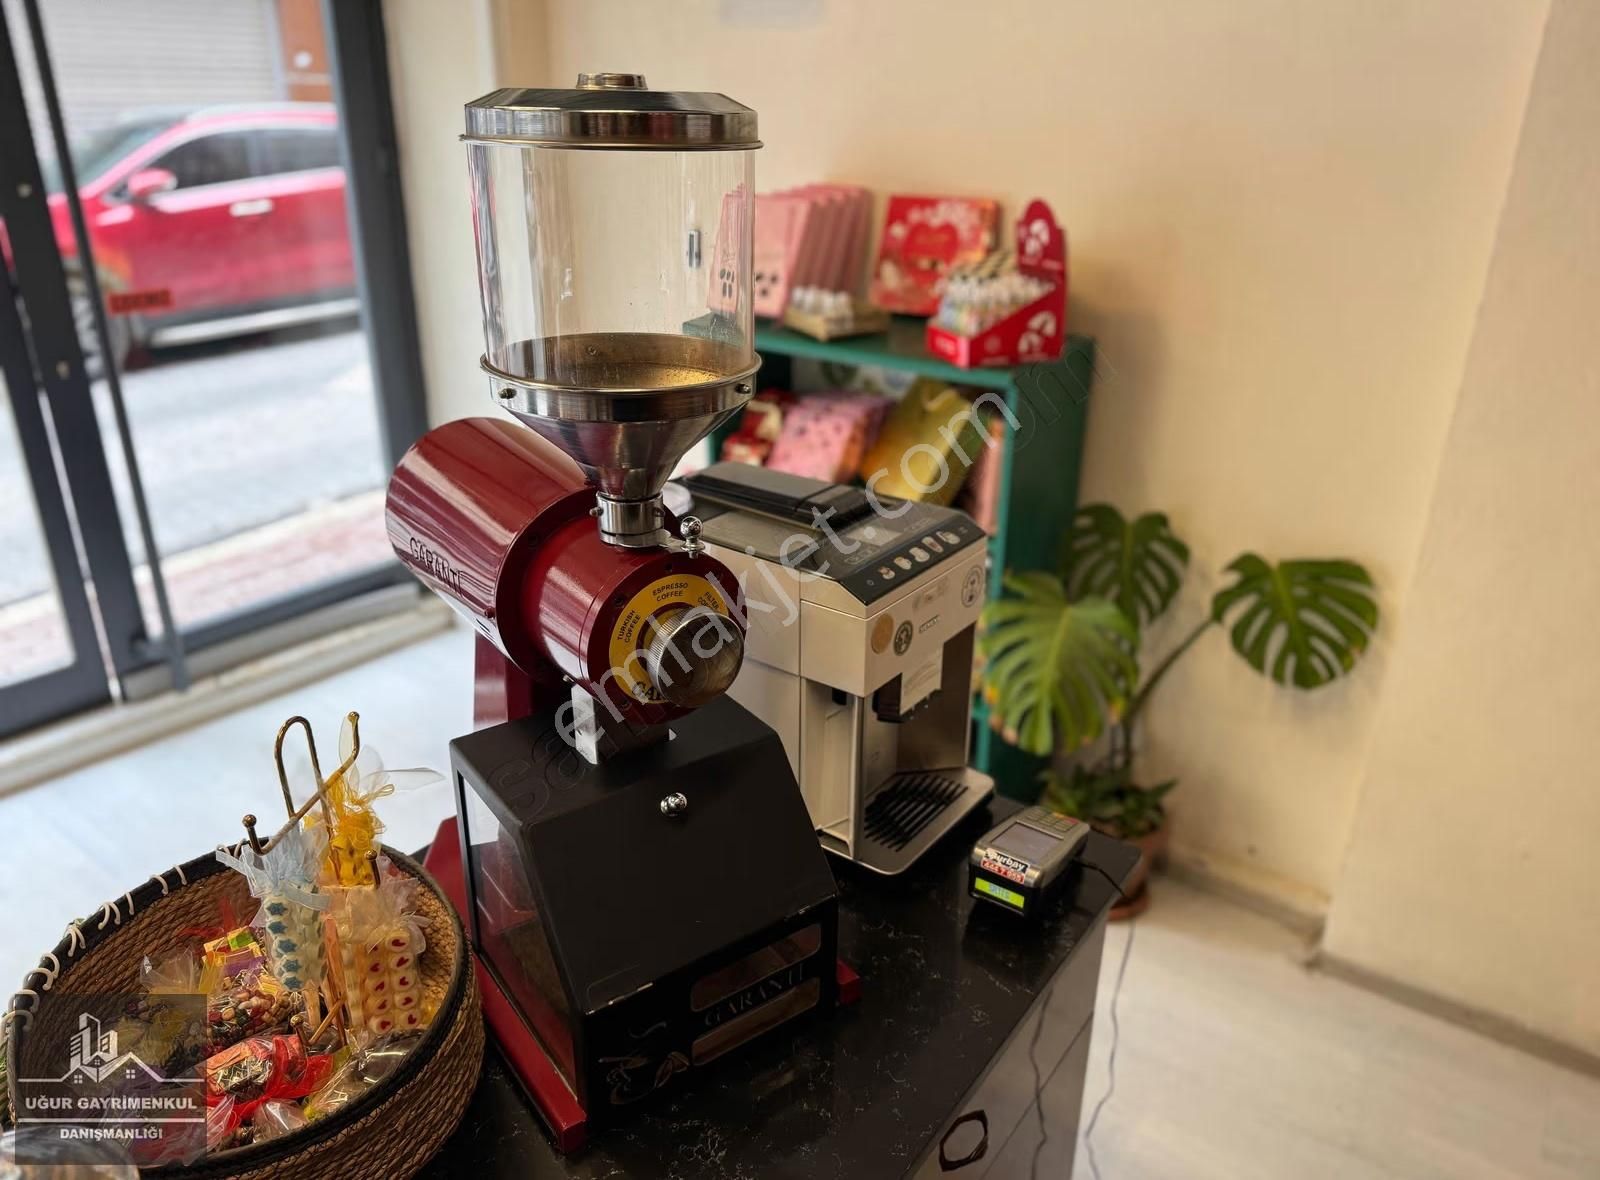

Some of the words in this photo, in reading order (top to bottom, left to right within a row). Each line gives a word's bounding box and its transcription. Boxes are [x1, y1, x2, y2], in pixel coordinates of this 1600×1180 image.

[652, 582, 689, 597] ESPRESSO
[656, 590, 684, 602] COFFEE
[704, 591, 720, 610] FILTER
[617, 609, 636, 641] TURKISH
[625, 614, 641, 643] COFFEE
